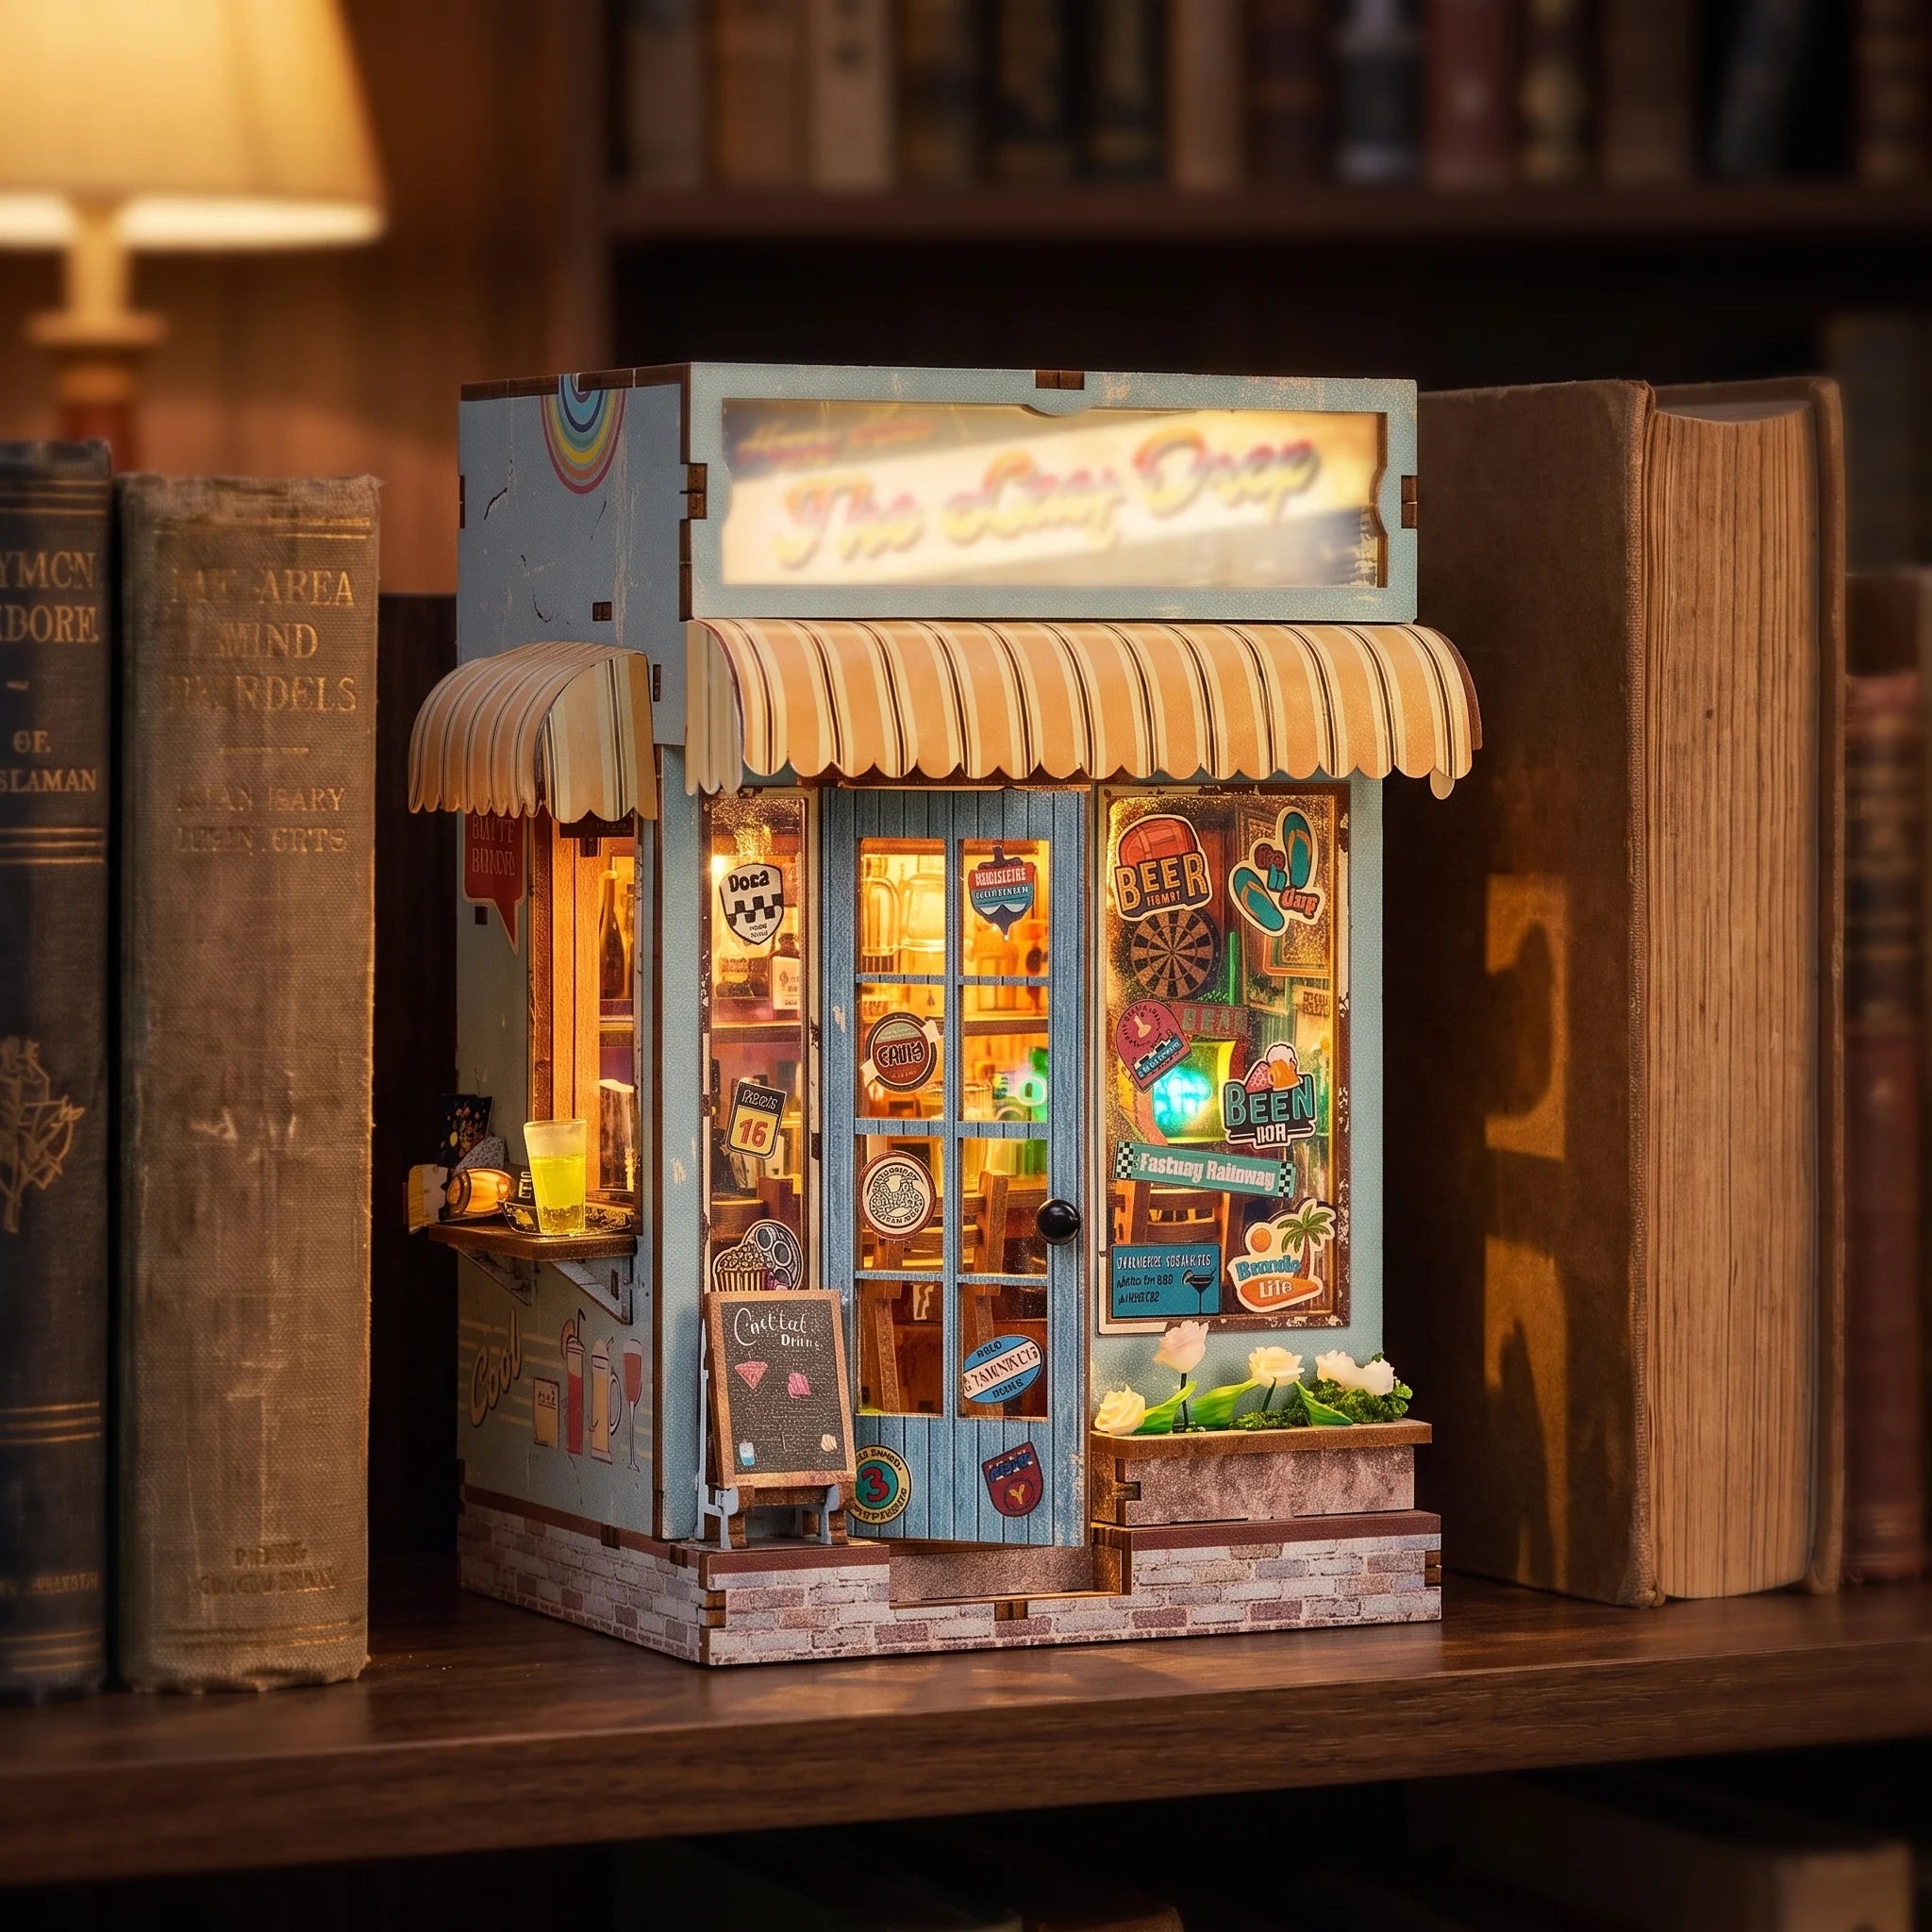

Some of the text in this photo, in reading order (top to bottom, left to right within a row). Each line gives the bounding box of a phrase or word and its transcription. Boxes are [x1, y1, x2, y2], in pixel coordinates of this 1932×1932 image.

[258, 569, 355, 606] AREA
[1115, 853, 1208, 912] BEER
[1225, 1075, 1313, 1126] BEEN
[740, 1118, 769, 1147] 16
[861, 1467, 891, 1503] 3
